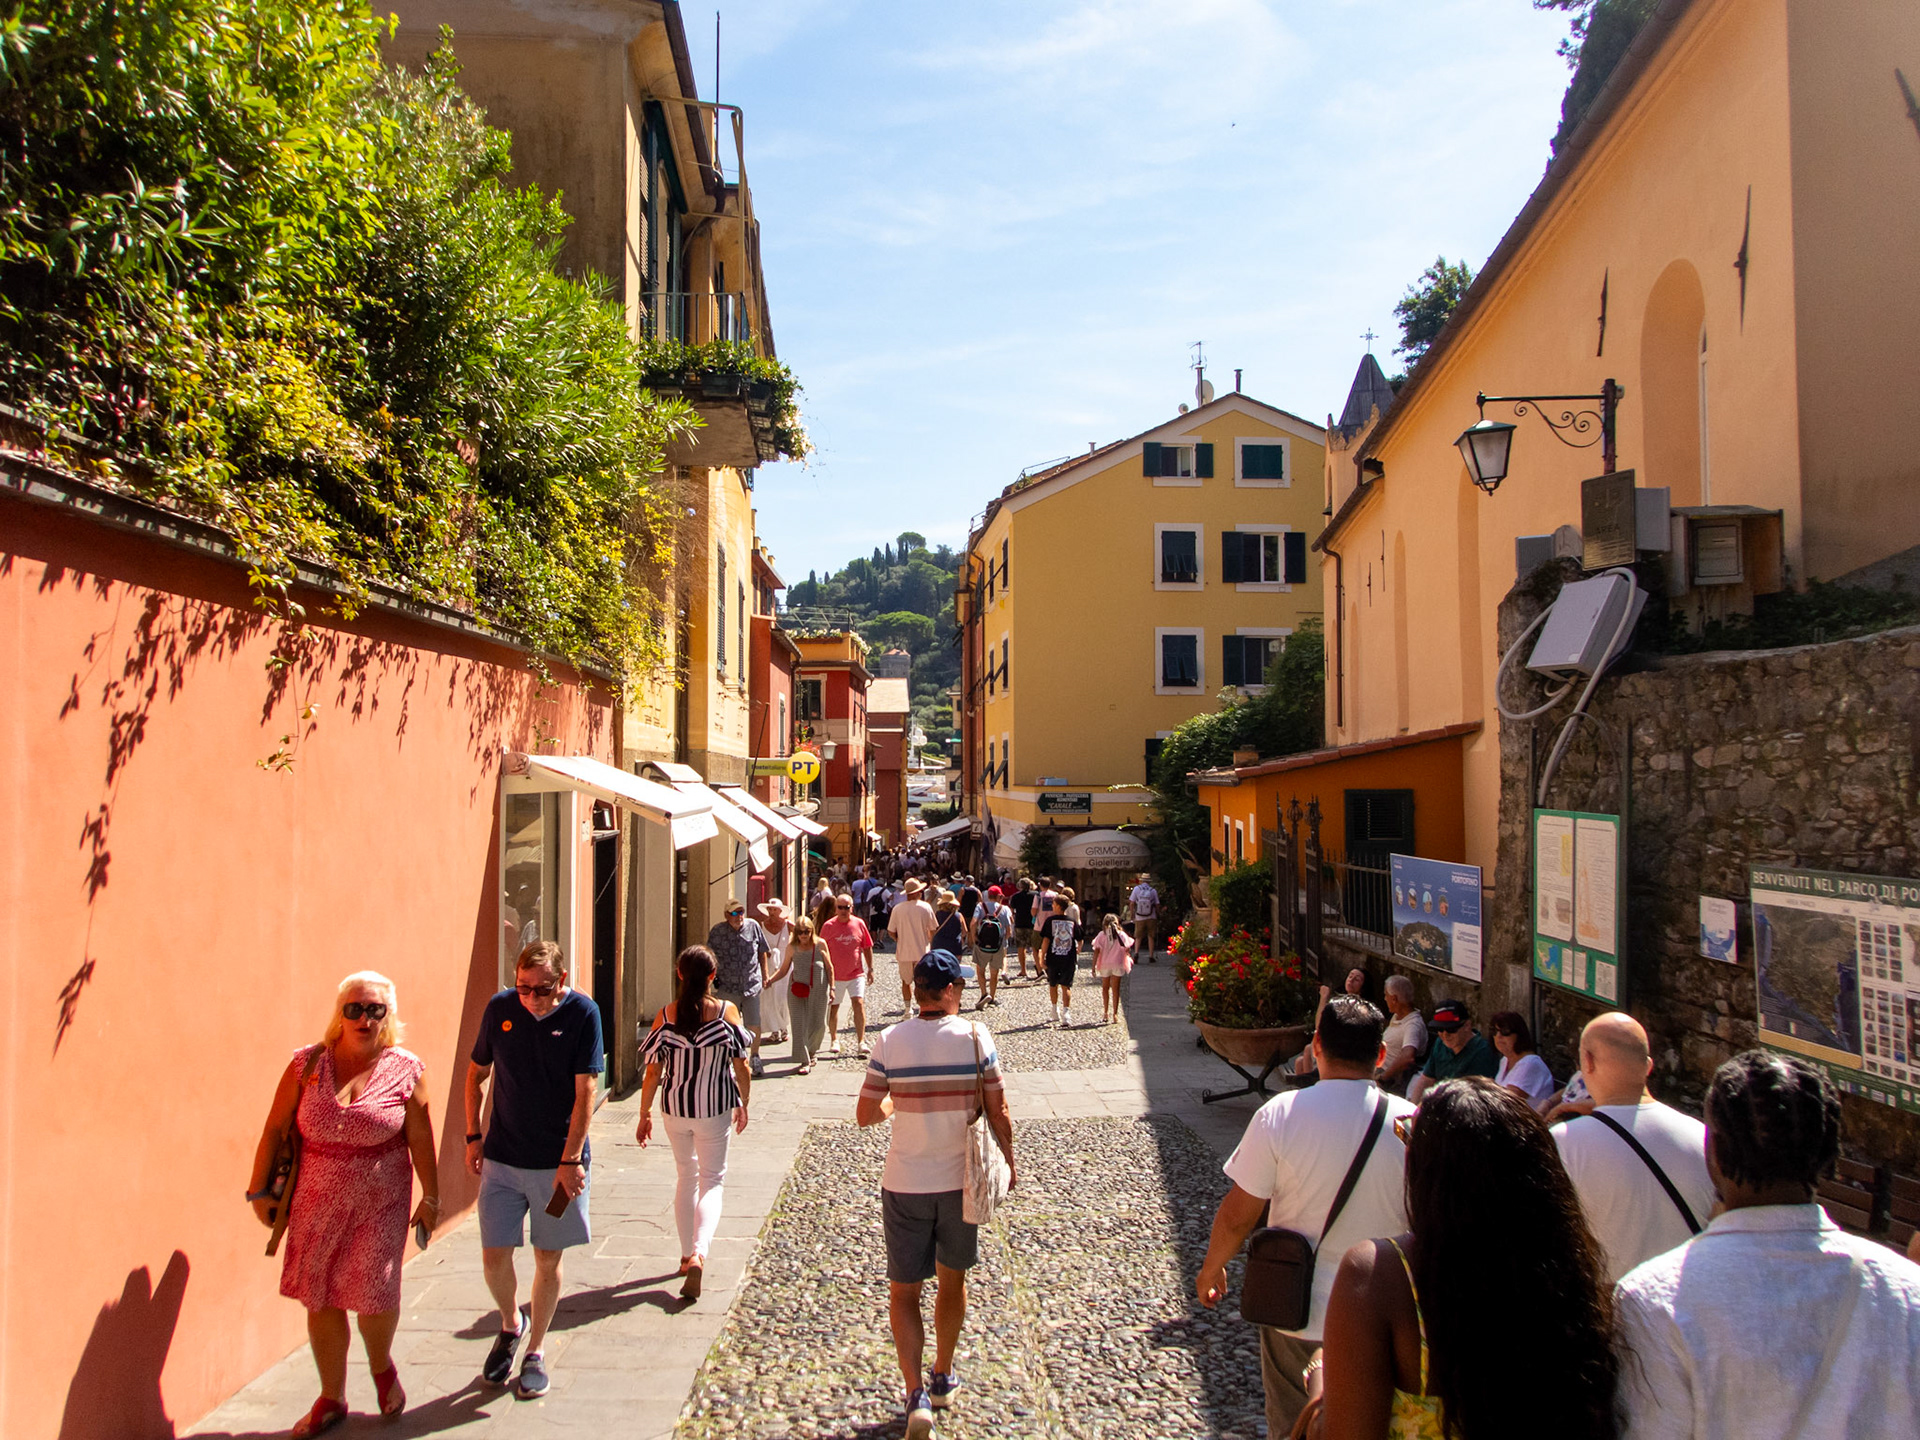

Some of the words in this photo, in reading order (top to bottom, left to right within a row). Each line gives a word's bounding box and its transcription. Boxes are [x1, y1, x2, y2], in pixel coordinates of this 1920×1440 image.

[792, 761, 815, 775] PT
[1085, 845, 1131, 855] GRIMOLDI
[1088, 858, 1130, 867] Gioielleria
[1752, 871, 1811, 890] BENVENUTI
[1813, 877, 1835, 893] NEL
[1838, 880, 1878, 897] PARCO
[1881, 884, 1898, 900] DI
[1902, 886, 1920, 902] PO
